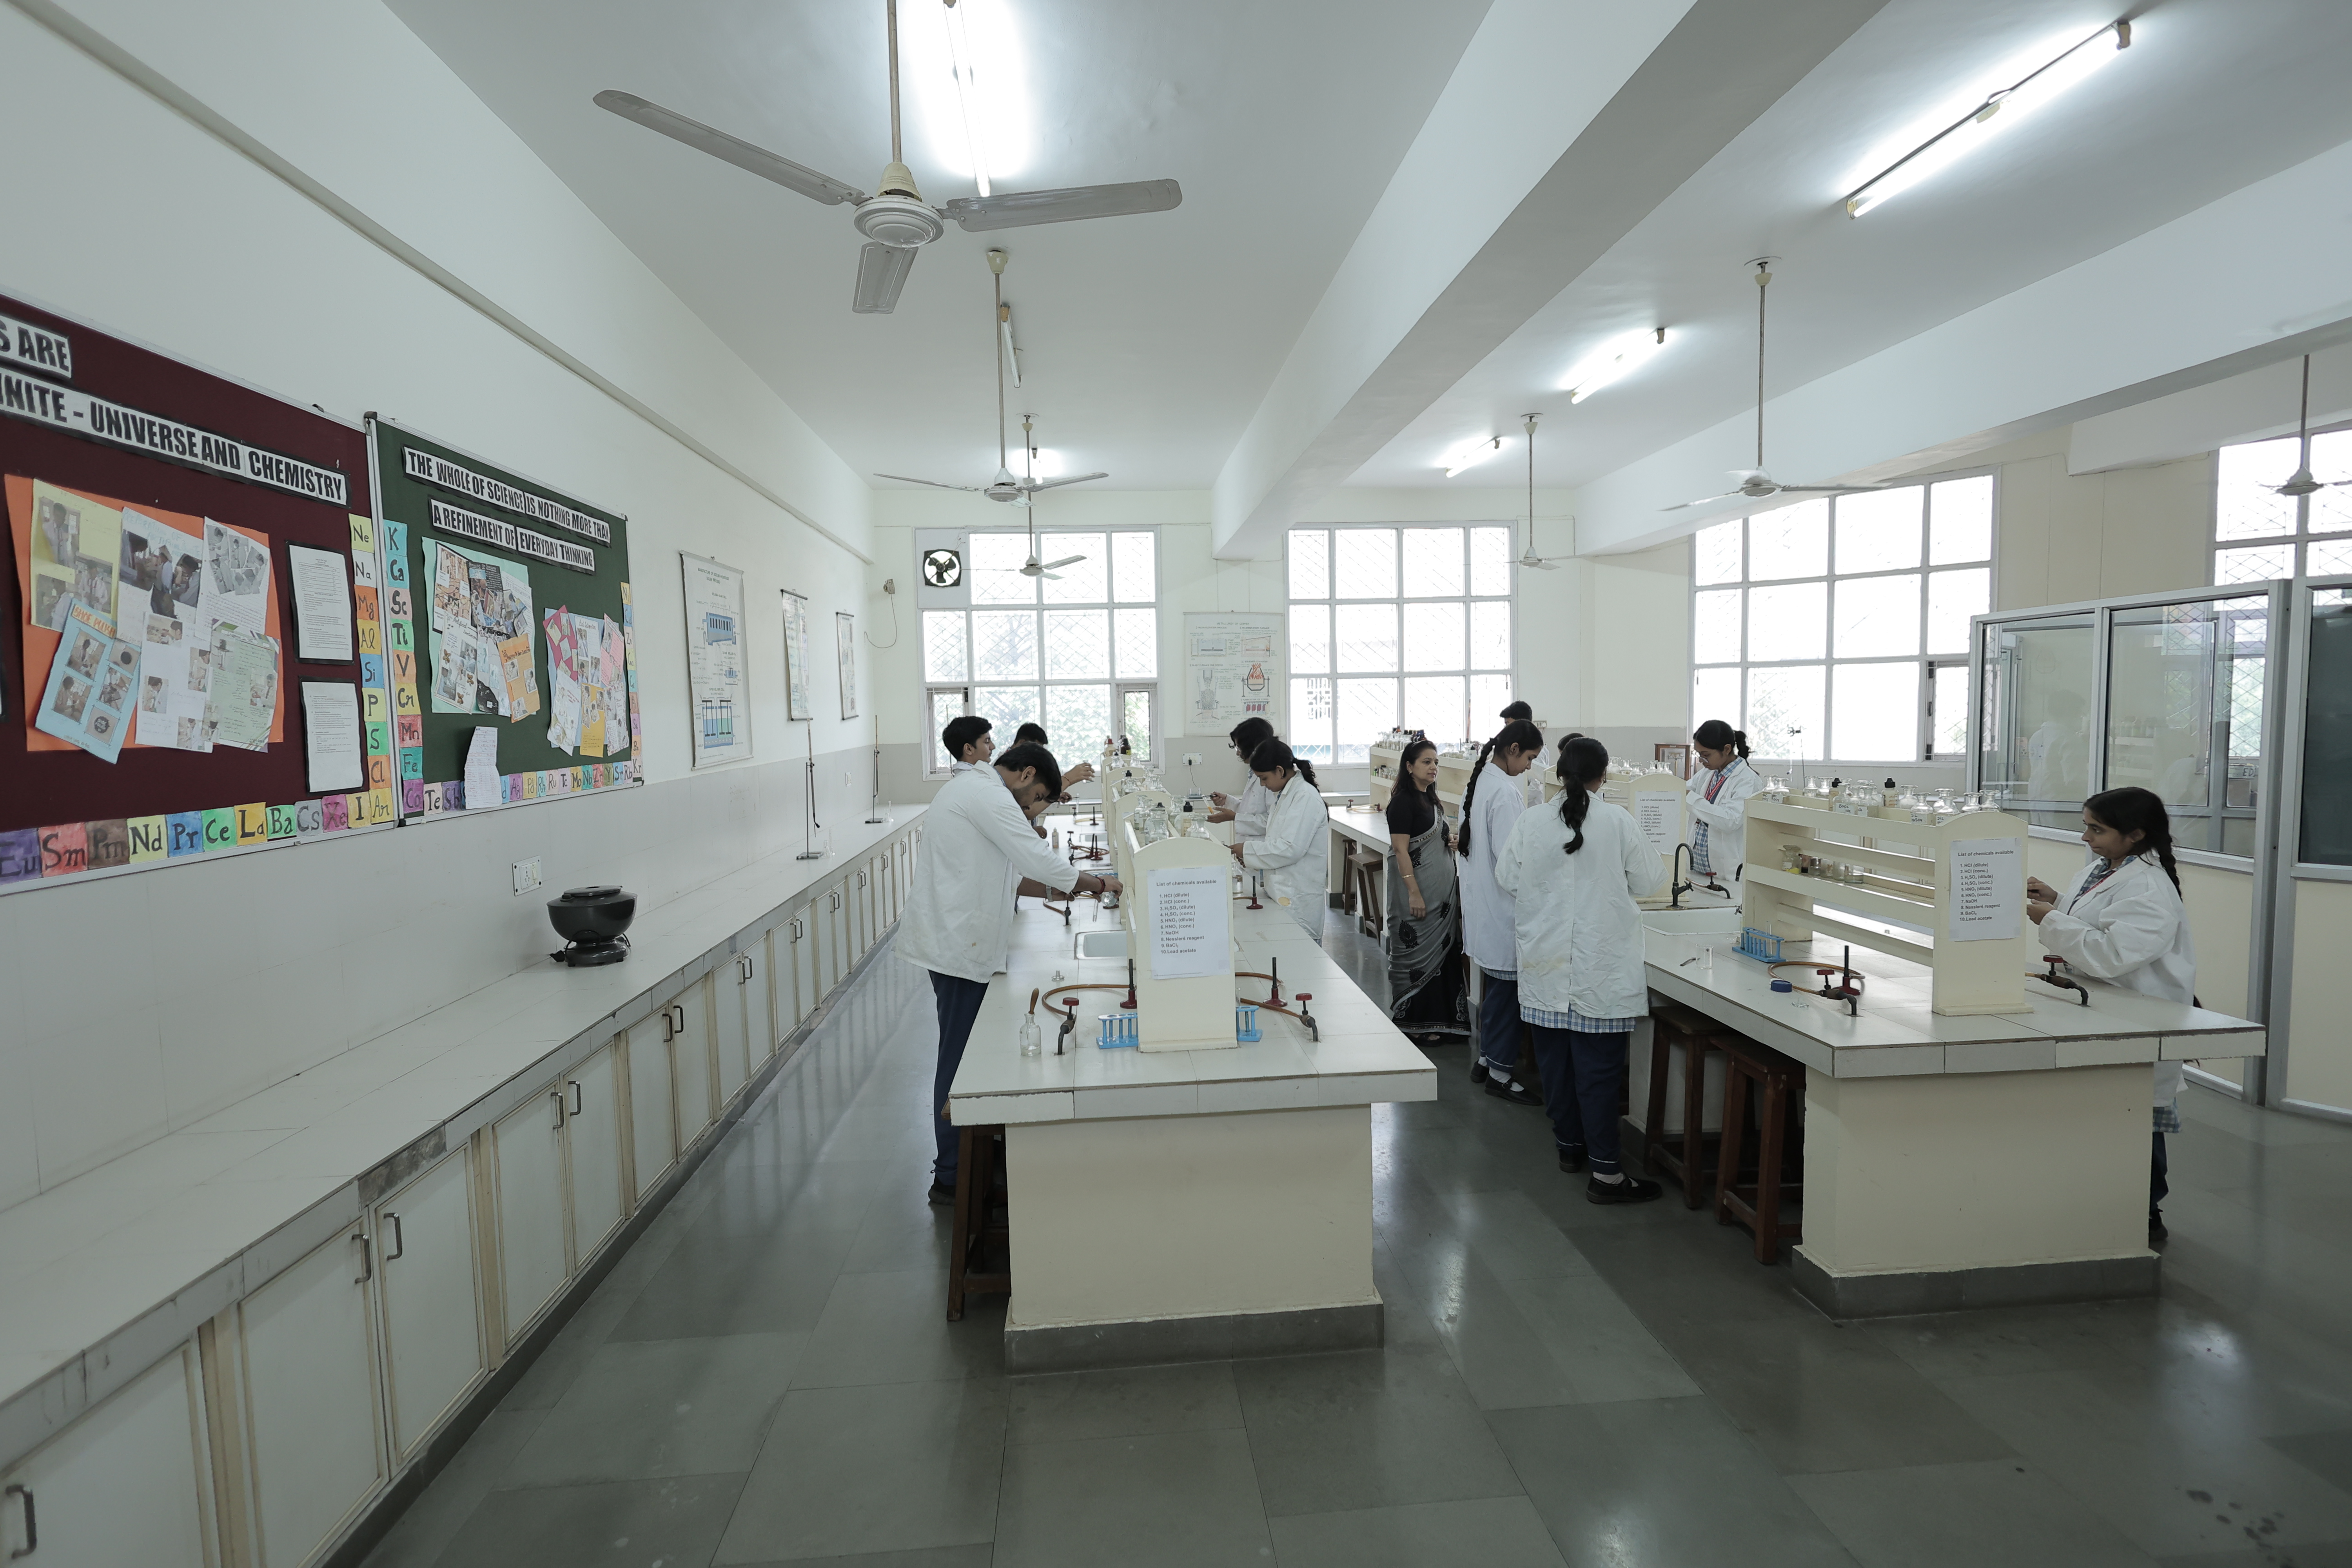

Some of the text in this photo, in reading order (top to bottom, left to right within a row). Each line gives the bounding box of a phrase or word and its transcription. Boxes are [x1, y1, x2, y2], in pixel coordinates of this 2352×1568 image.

[18, 326, 69, 372] ARE
[90, 401, 199, 458] UNIVERSE
[201, 437, 241, 470] AND
[248, 451, 342, 501] CHEMISTRY
[408, 452, 609, 541] THE WHOLE OF SCIENCE IS NOTHING MORE THAN
[353, 524, 369, 543] Ne
[388, 526, 399, 551] K
[434, 505, 593, 567] A REFINEMENT OF EVERYDAY THINKING
[355, 561, 372, 580] Na
[390, 559, 404, 582] Ca
[391, 590, 407, 615] Sc
[622, 586, 630, 601] Ni
[358, 593, 374, 620] Mg
[625, 609, 632, 625] Cu
[361, 628, 375, 650] Al
[392, 622, 408, 645] Ti
[365, 661, 375, 682] Si
[396, 654, 409, 677] V
[368, 694, 378, 716] P
[397, 687, 414, 708] Cr
[370, 728, 379, 750] S
[401, 722, 419, 741] Mn
[371, 760, 384, 783] Cl
[403, 753, 418, 773] Fe
[406, 788, 421, 808] Co
[425, 789, 440, 811] Te
[444, 787, 460, 811] Sb
[502, 780, 506, 799] d
[511, 778, 521, 799] Ag
[528, 778, 534, 794] Pd
[538, 776, 546, 793] Rh
[548, 773, 557, 790] Ru
[561, 774, 568, 788] Tc
[571, 772, 582, 788] Mo
[583, 770, 592, 785] Nb
[605, 767, 611, 782] Y
[615, 766, 624, 781] Sr
[624, 764, 633, 780] Rb
[633, 759, 642, 773] Kr
[0, 795, 389, 877] Eu Sm Pm Nd Pr Ce La Ba Cs Xe I Ar
